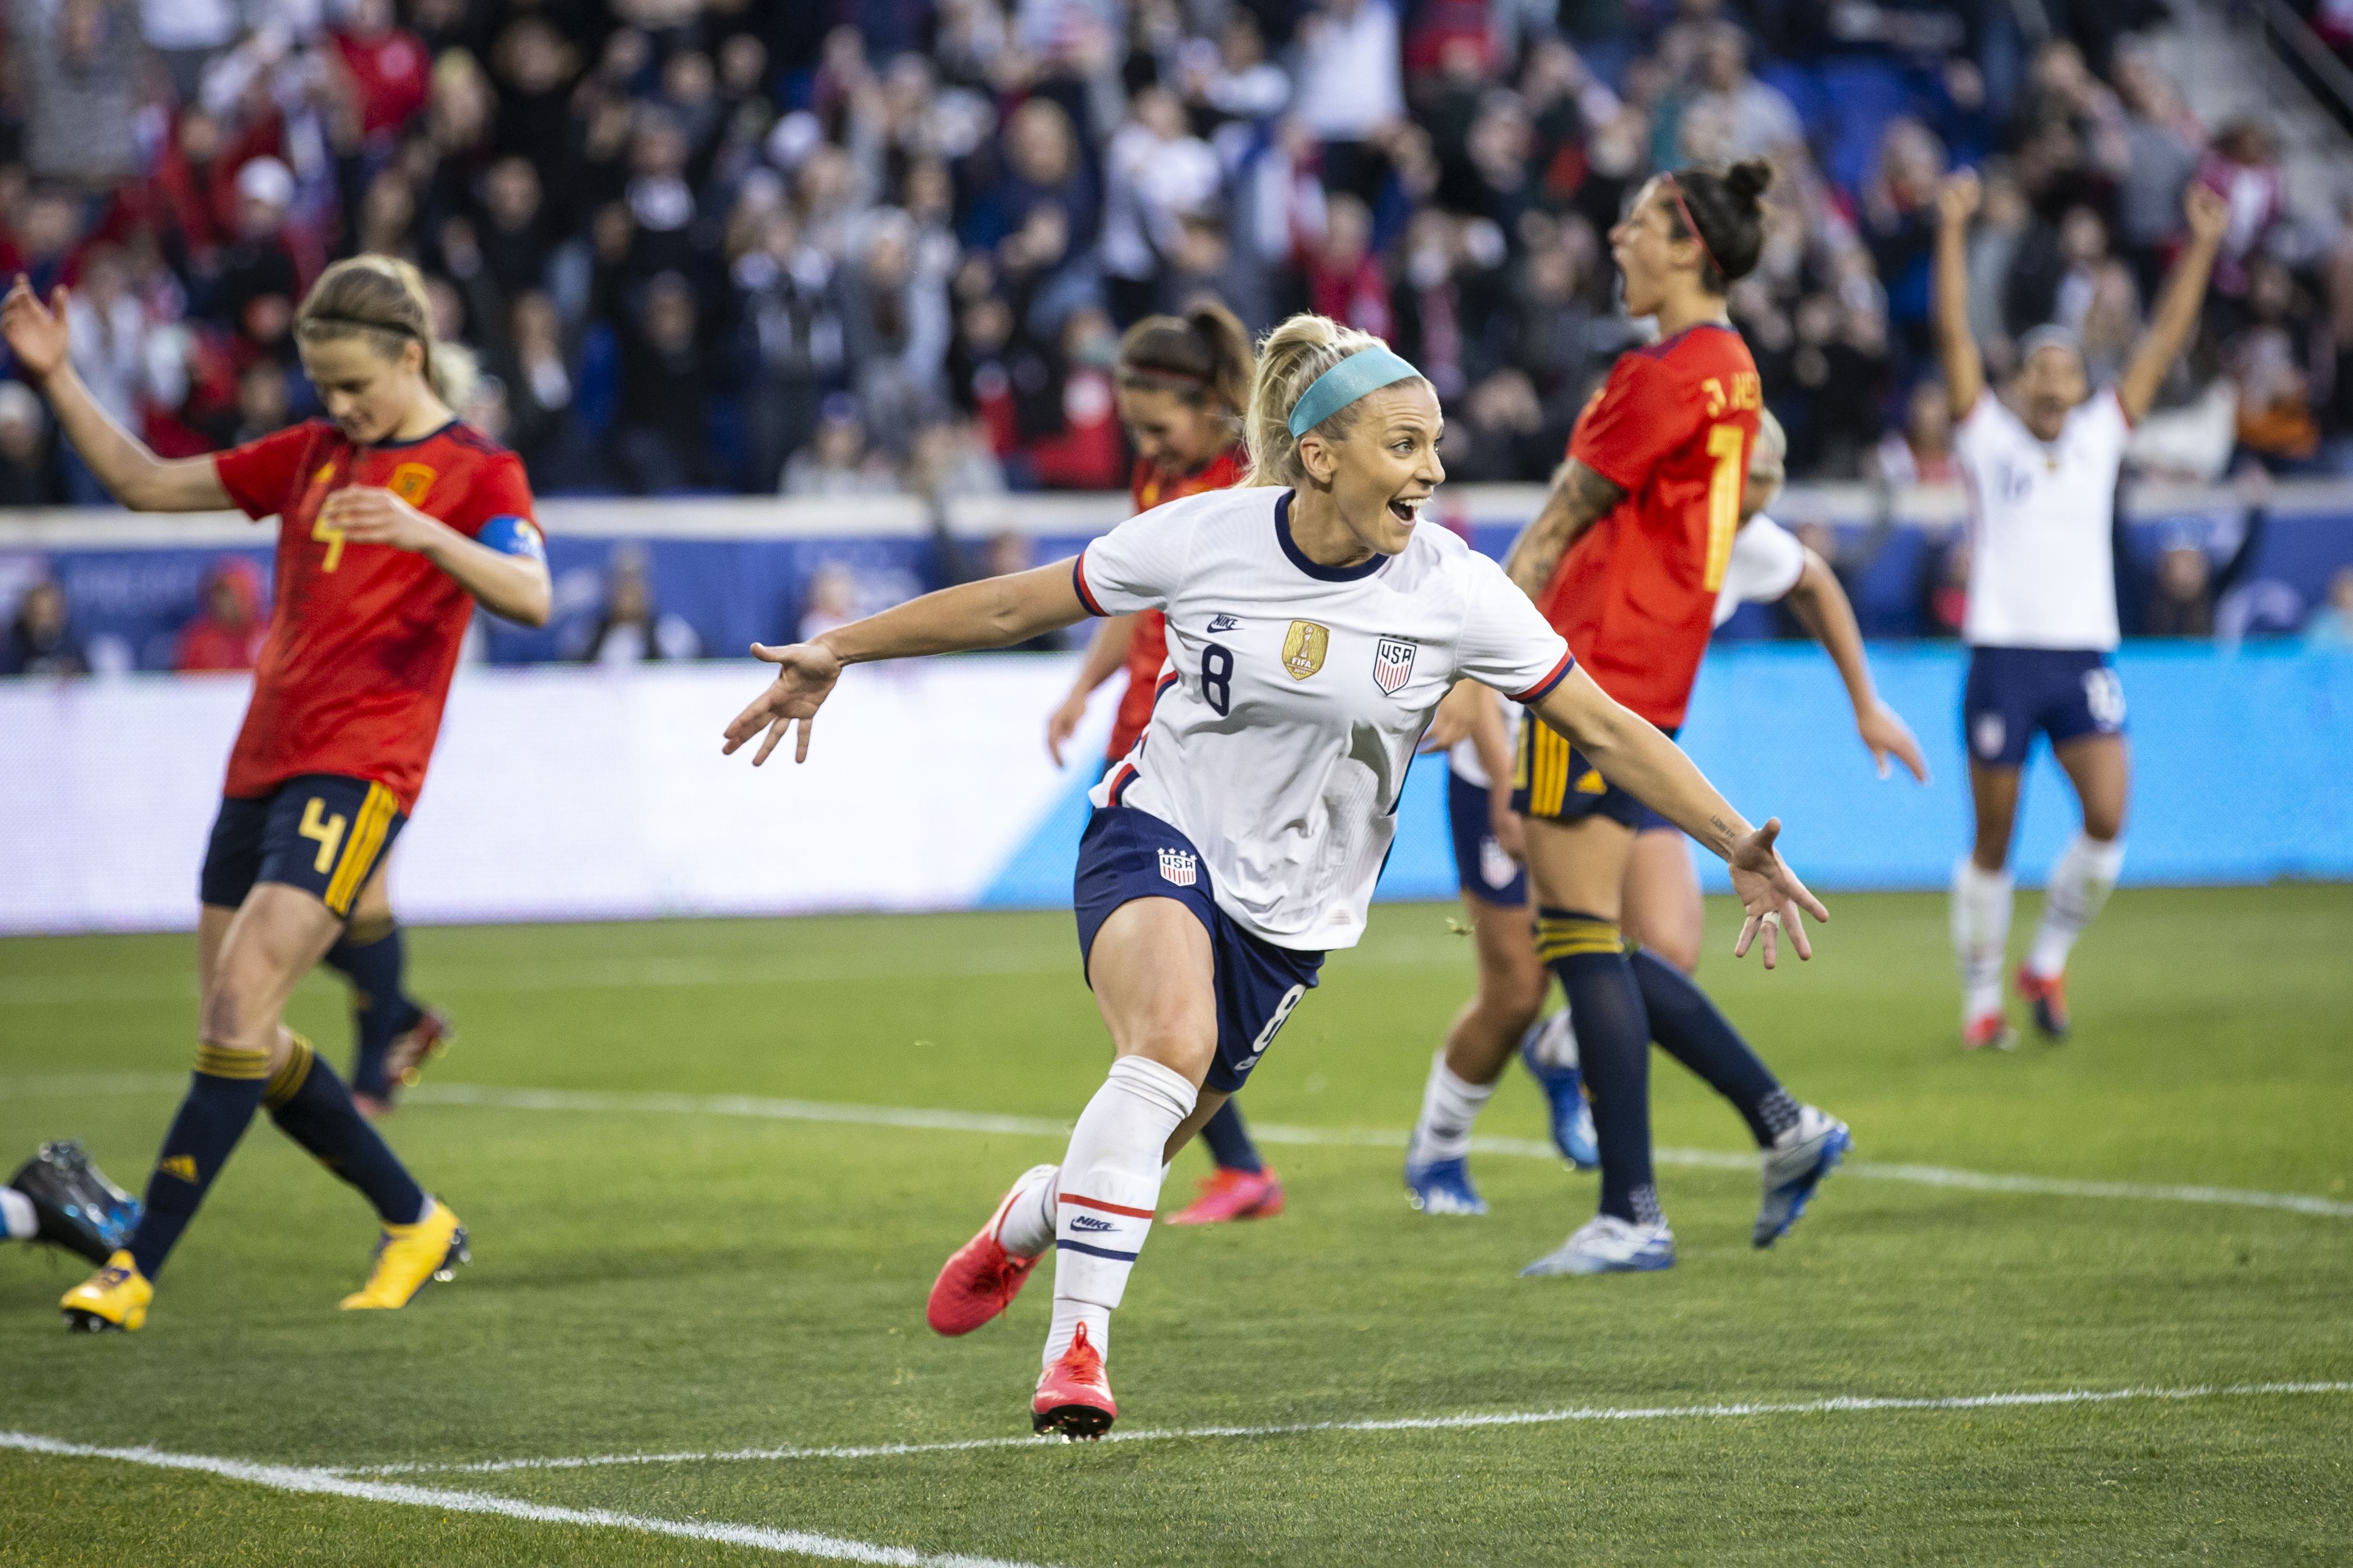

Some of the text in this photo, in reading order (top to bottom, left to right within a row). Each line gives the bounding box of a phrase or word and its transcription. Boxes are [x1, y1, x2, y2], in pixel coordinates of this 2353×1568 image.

[1213, 613, 1238, 629] NIKE
[1291, 656, 1312, 669] FIFA
[1381, 644, 1412, 665] USA
[1202, 644, 1234, 717] 8
[298, 796, 348, 875] 4
[1163, 856, 1193, 869] USA
[1252, 983, 1307, 1053] 8
[1076, 1215, 1115, 1230] NIKE
